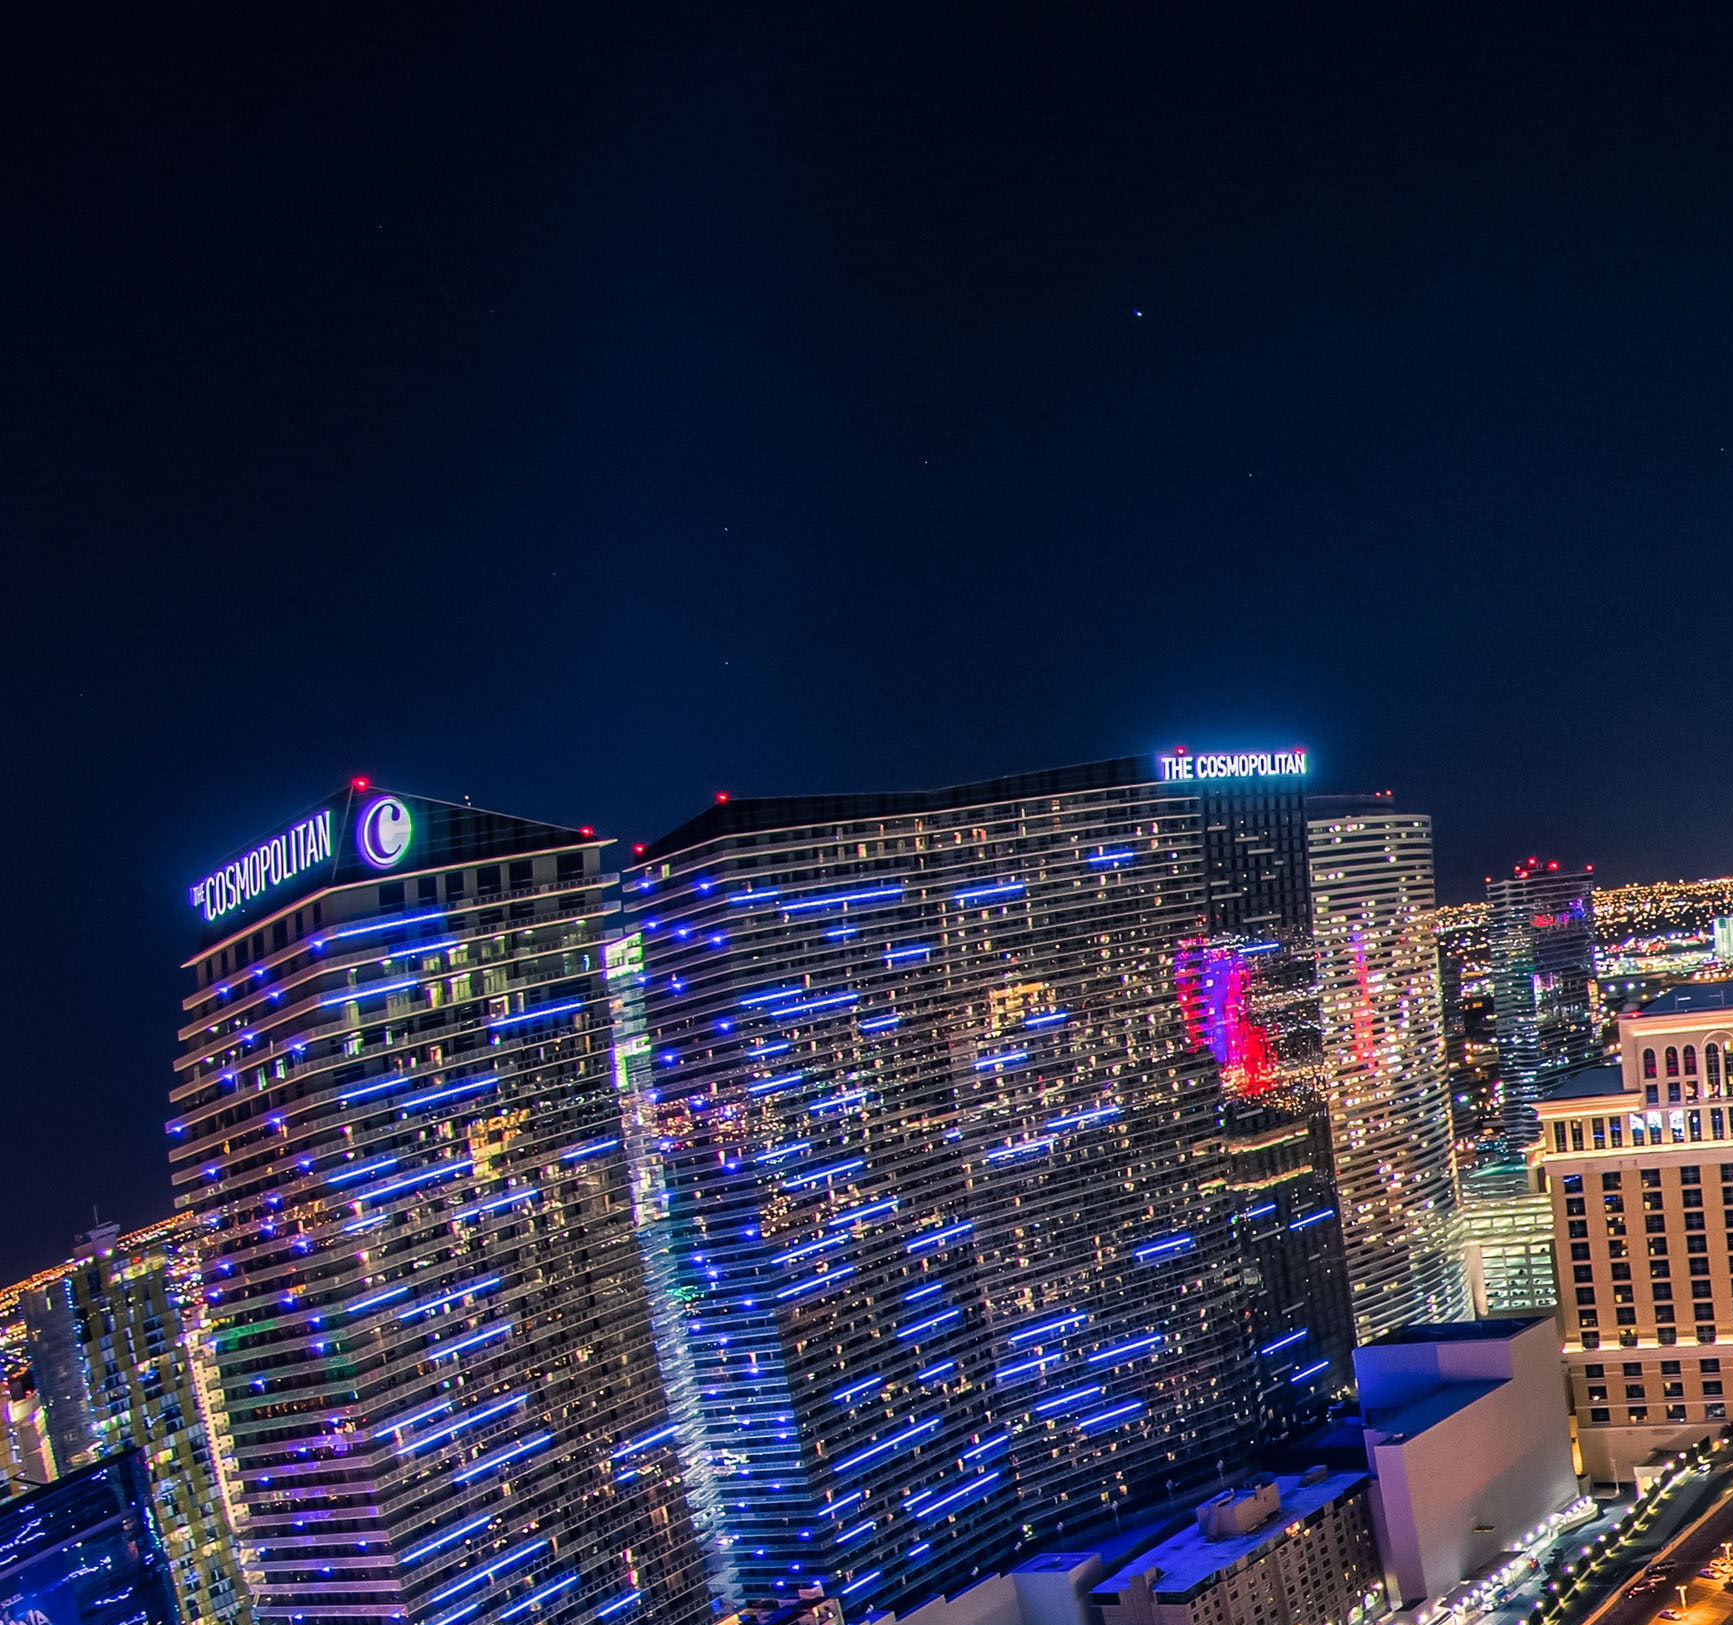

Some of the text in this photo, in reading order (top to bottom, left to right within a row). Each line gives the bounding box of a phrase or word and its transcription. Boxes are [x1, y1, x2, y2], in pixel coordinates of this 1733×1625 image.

[1161, 753, 1306, 780] THE COSMOPOLITAN
[192, 810, 332, 922] THE COSMOPOLITAN
